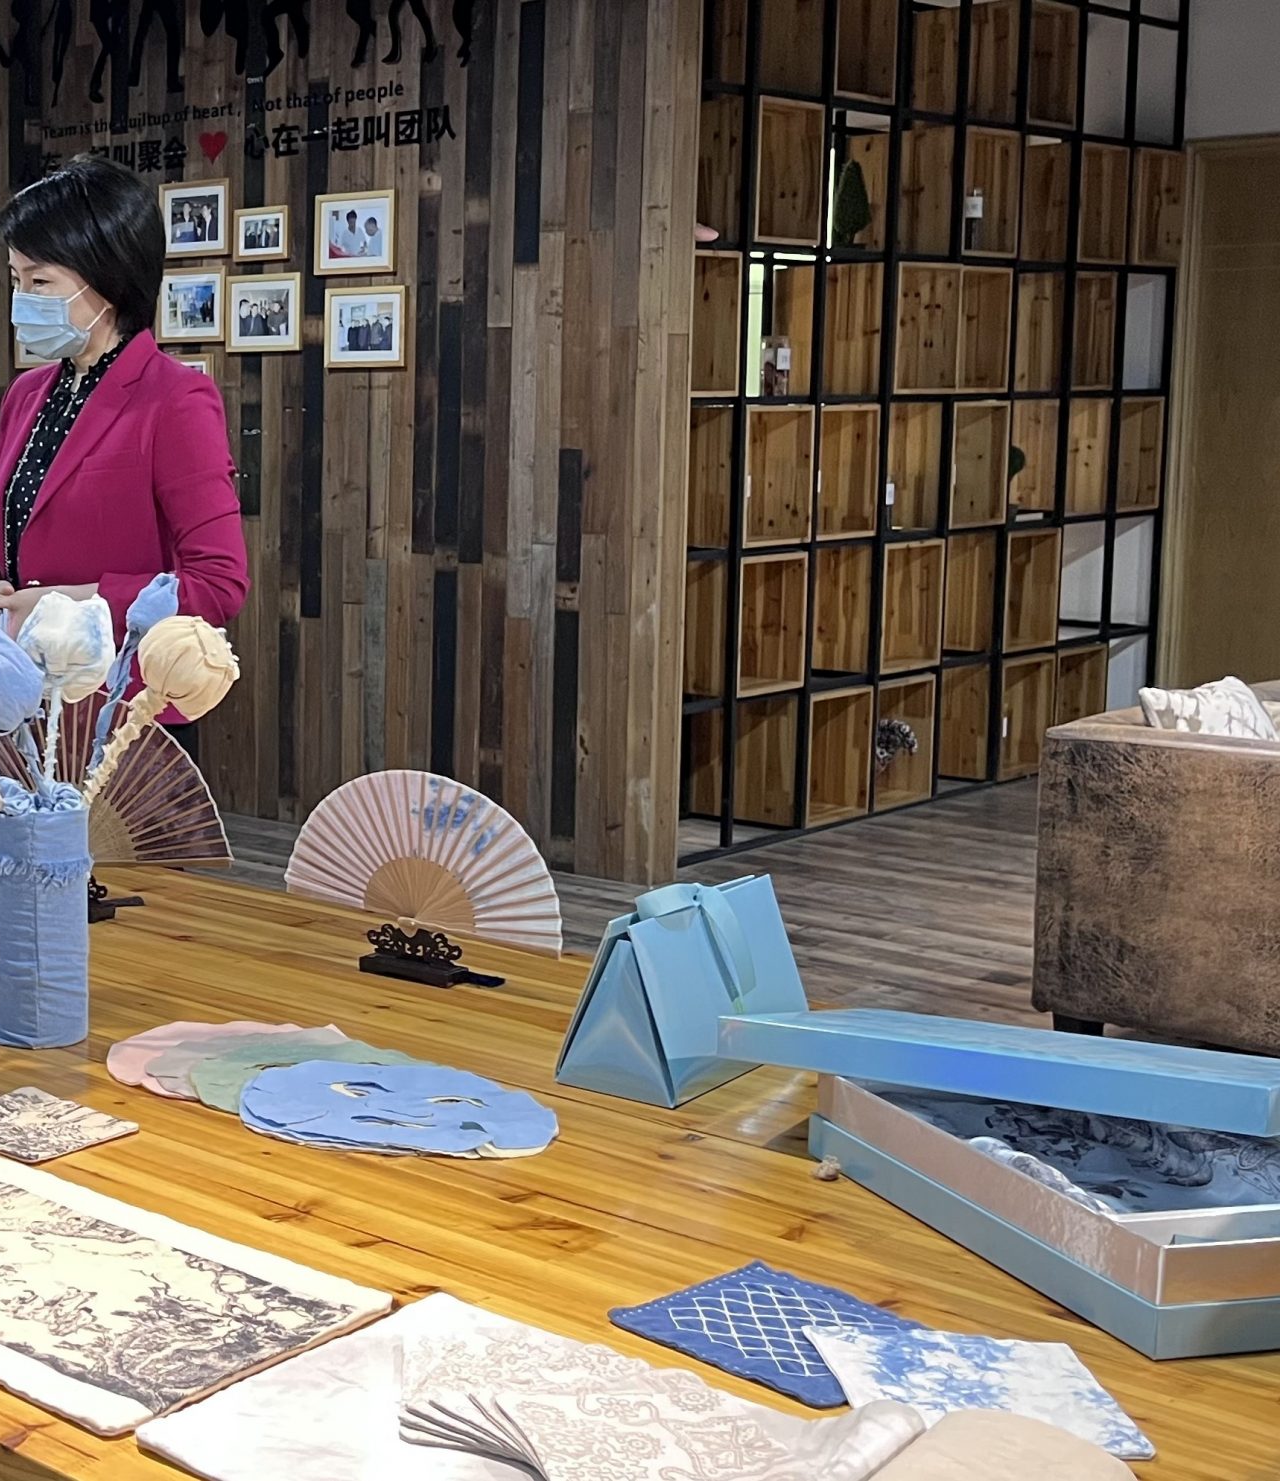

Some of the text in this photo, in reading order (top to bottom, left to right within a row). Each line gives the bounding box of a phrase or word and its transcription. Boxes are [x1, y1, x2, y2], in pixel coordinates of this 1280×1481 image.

[42, 125, 77, 140] Team
[80, 122, 91, 135] is
[95, 118, 117, 133] the
[174, 106, 190, 121] of
[252, 97, 282, 112] Not
[286, 93, 318, 109] that
[324, 89, 341, 105] of
[346, 81, 404, 107] people
[244, 105, 457, 159] 心在一起叫团队
